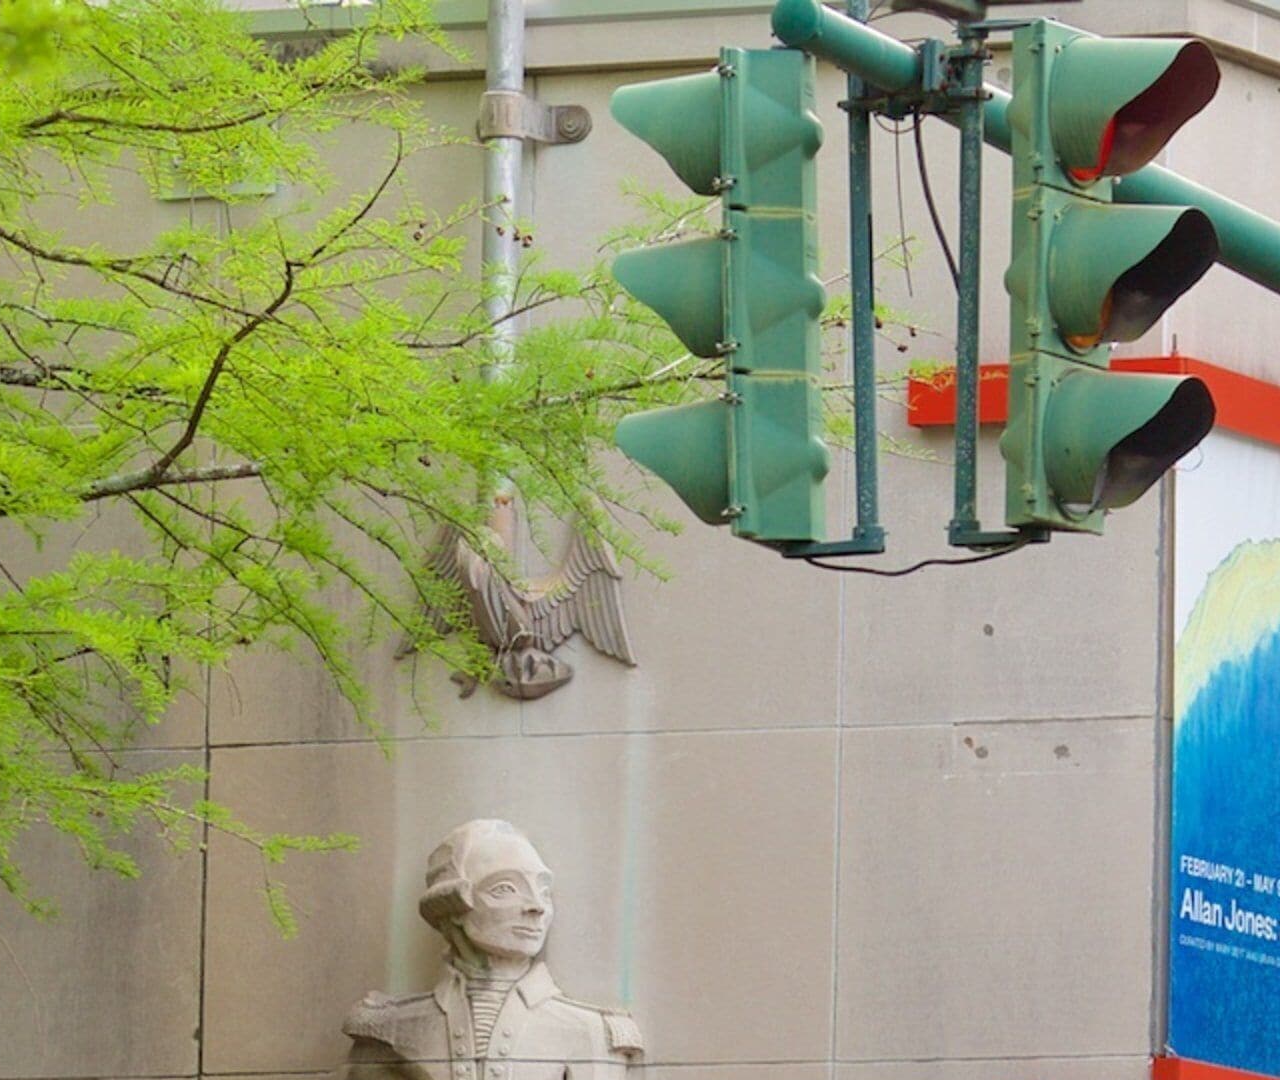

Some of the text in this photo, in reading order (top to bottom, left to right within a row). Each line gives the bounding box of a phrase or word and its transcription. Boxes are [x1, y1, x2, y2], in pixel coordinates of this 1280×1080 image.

[1180, 855, 1234, 886] FEBRUARY
[1253, 873, 1276, 895] MAY
[1180, 887, 1223, 928] Allan
[1223, 898, 1278, 942] Jones:
